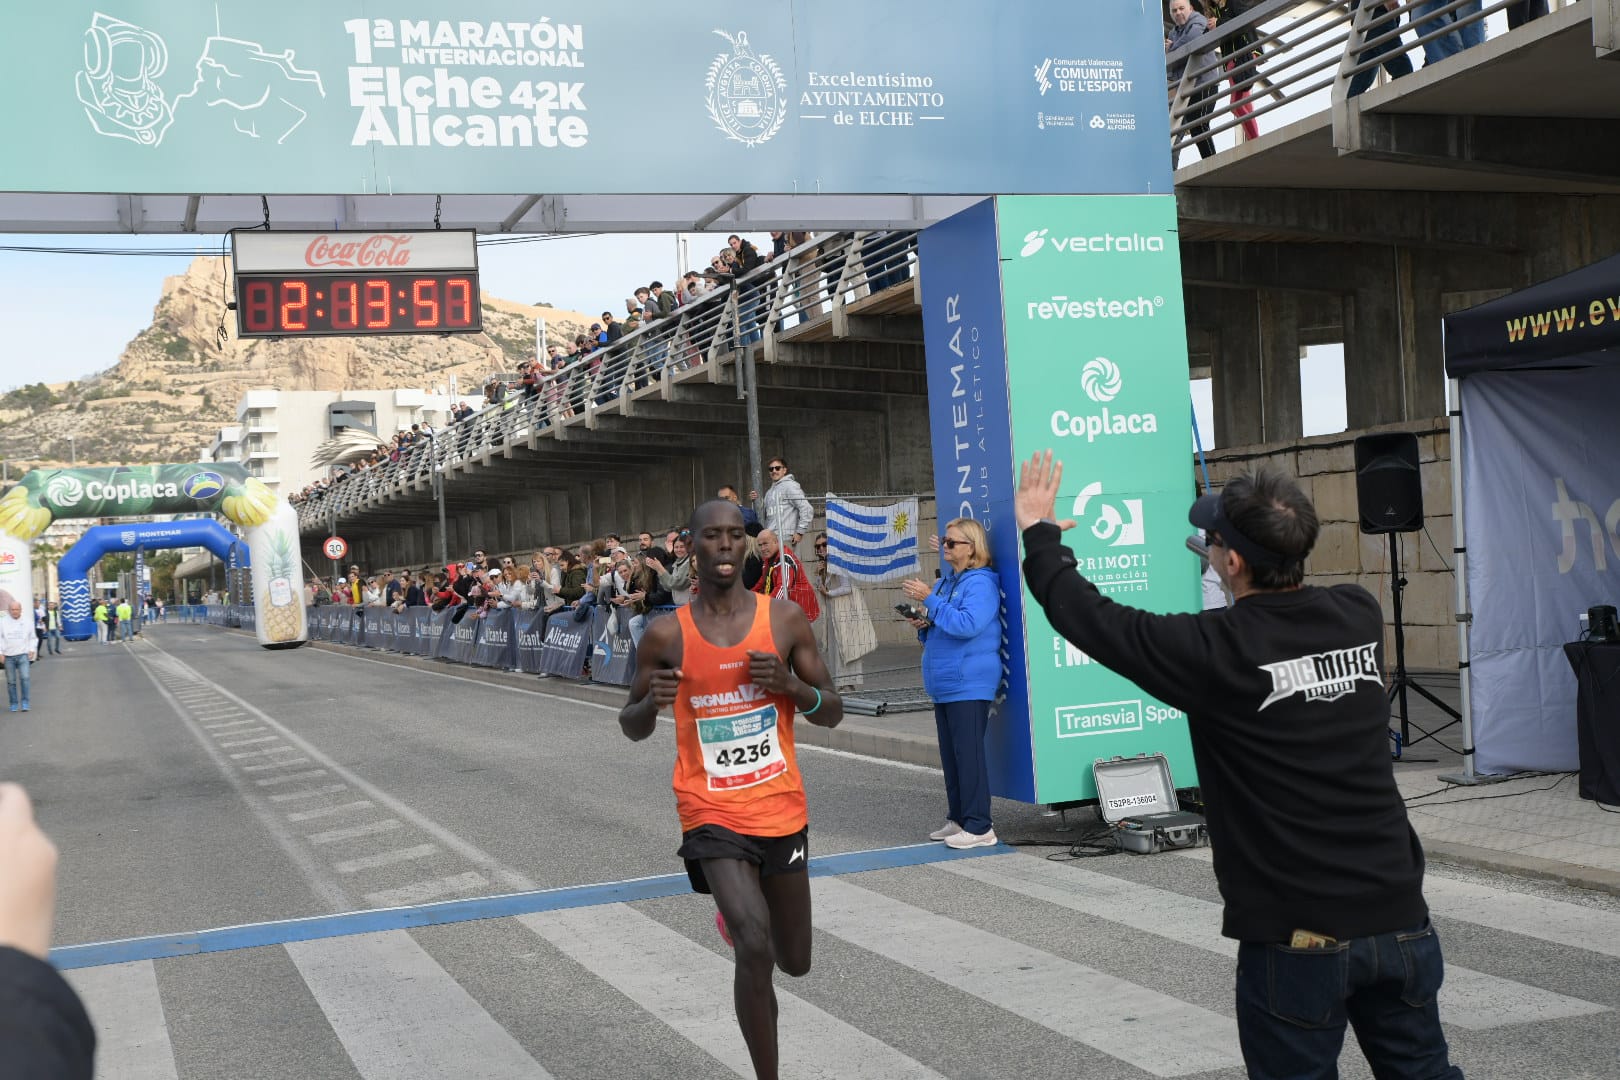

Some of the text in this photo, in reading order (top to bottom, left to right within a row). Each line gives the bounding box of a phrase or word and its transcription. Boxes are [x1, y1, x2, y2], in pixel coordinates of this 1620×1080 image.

[344, 16, 584, 64] 1ª MARATÓN
[402, 47, 585, 68] INTERNACIONAL
[1053, 58, 1123, 67] Comunitat Valenciana
[808, 71, 933, 88] Excelentísimo
[1053, 67, 1124, 80] COMUNITAT
[348, 66, 587, 112] Elche 42K
[1059, 79, 1133, 93] DE L'ESPORT
[799, 92, 944, 107] AYUNTAMIENTO
[351, 104, 589, 147] Alicante
[833, 111, 914, 126] de ELCHE
[304, 234, 413, 268] Coca-Cola
[1051, 232, 1164, 252] vectalia
[281, 279, 470, 329] 2:13:57
[1050, 407, 1158, 443] Coplaca
[85, 478, 178, 504] Coplaca
[979, 466, 993, 533] CLUB
[1084, 571, 1148, 582] utomoción
[1101, 583, 1149, 594] ustrial
[544, 626, 582, 649] Alicante
[1063, 708, 1136, 730] Transvia
[716, 738, 771, 768] 4236
